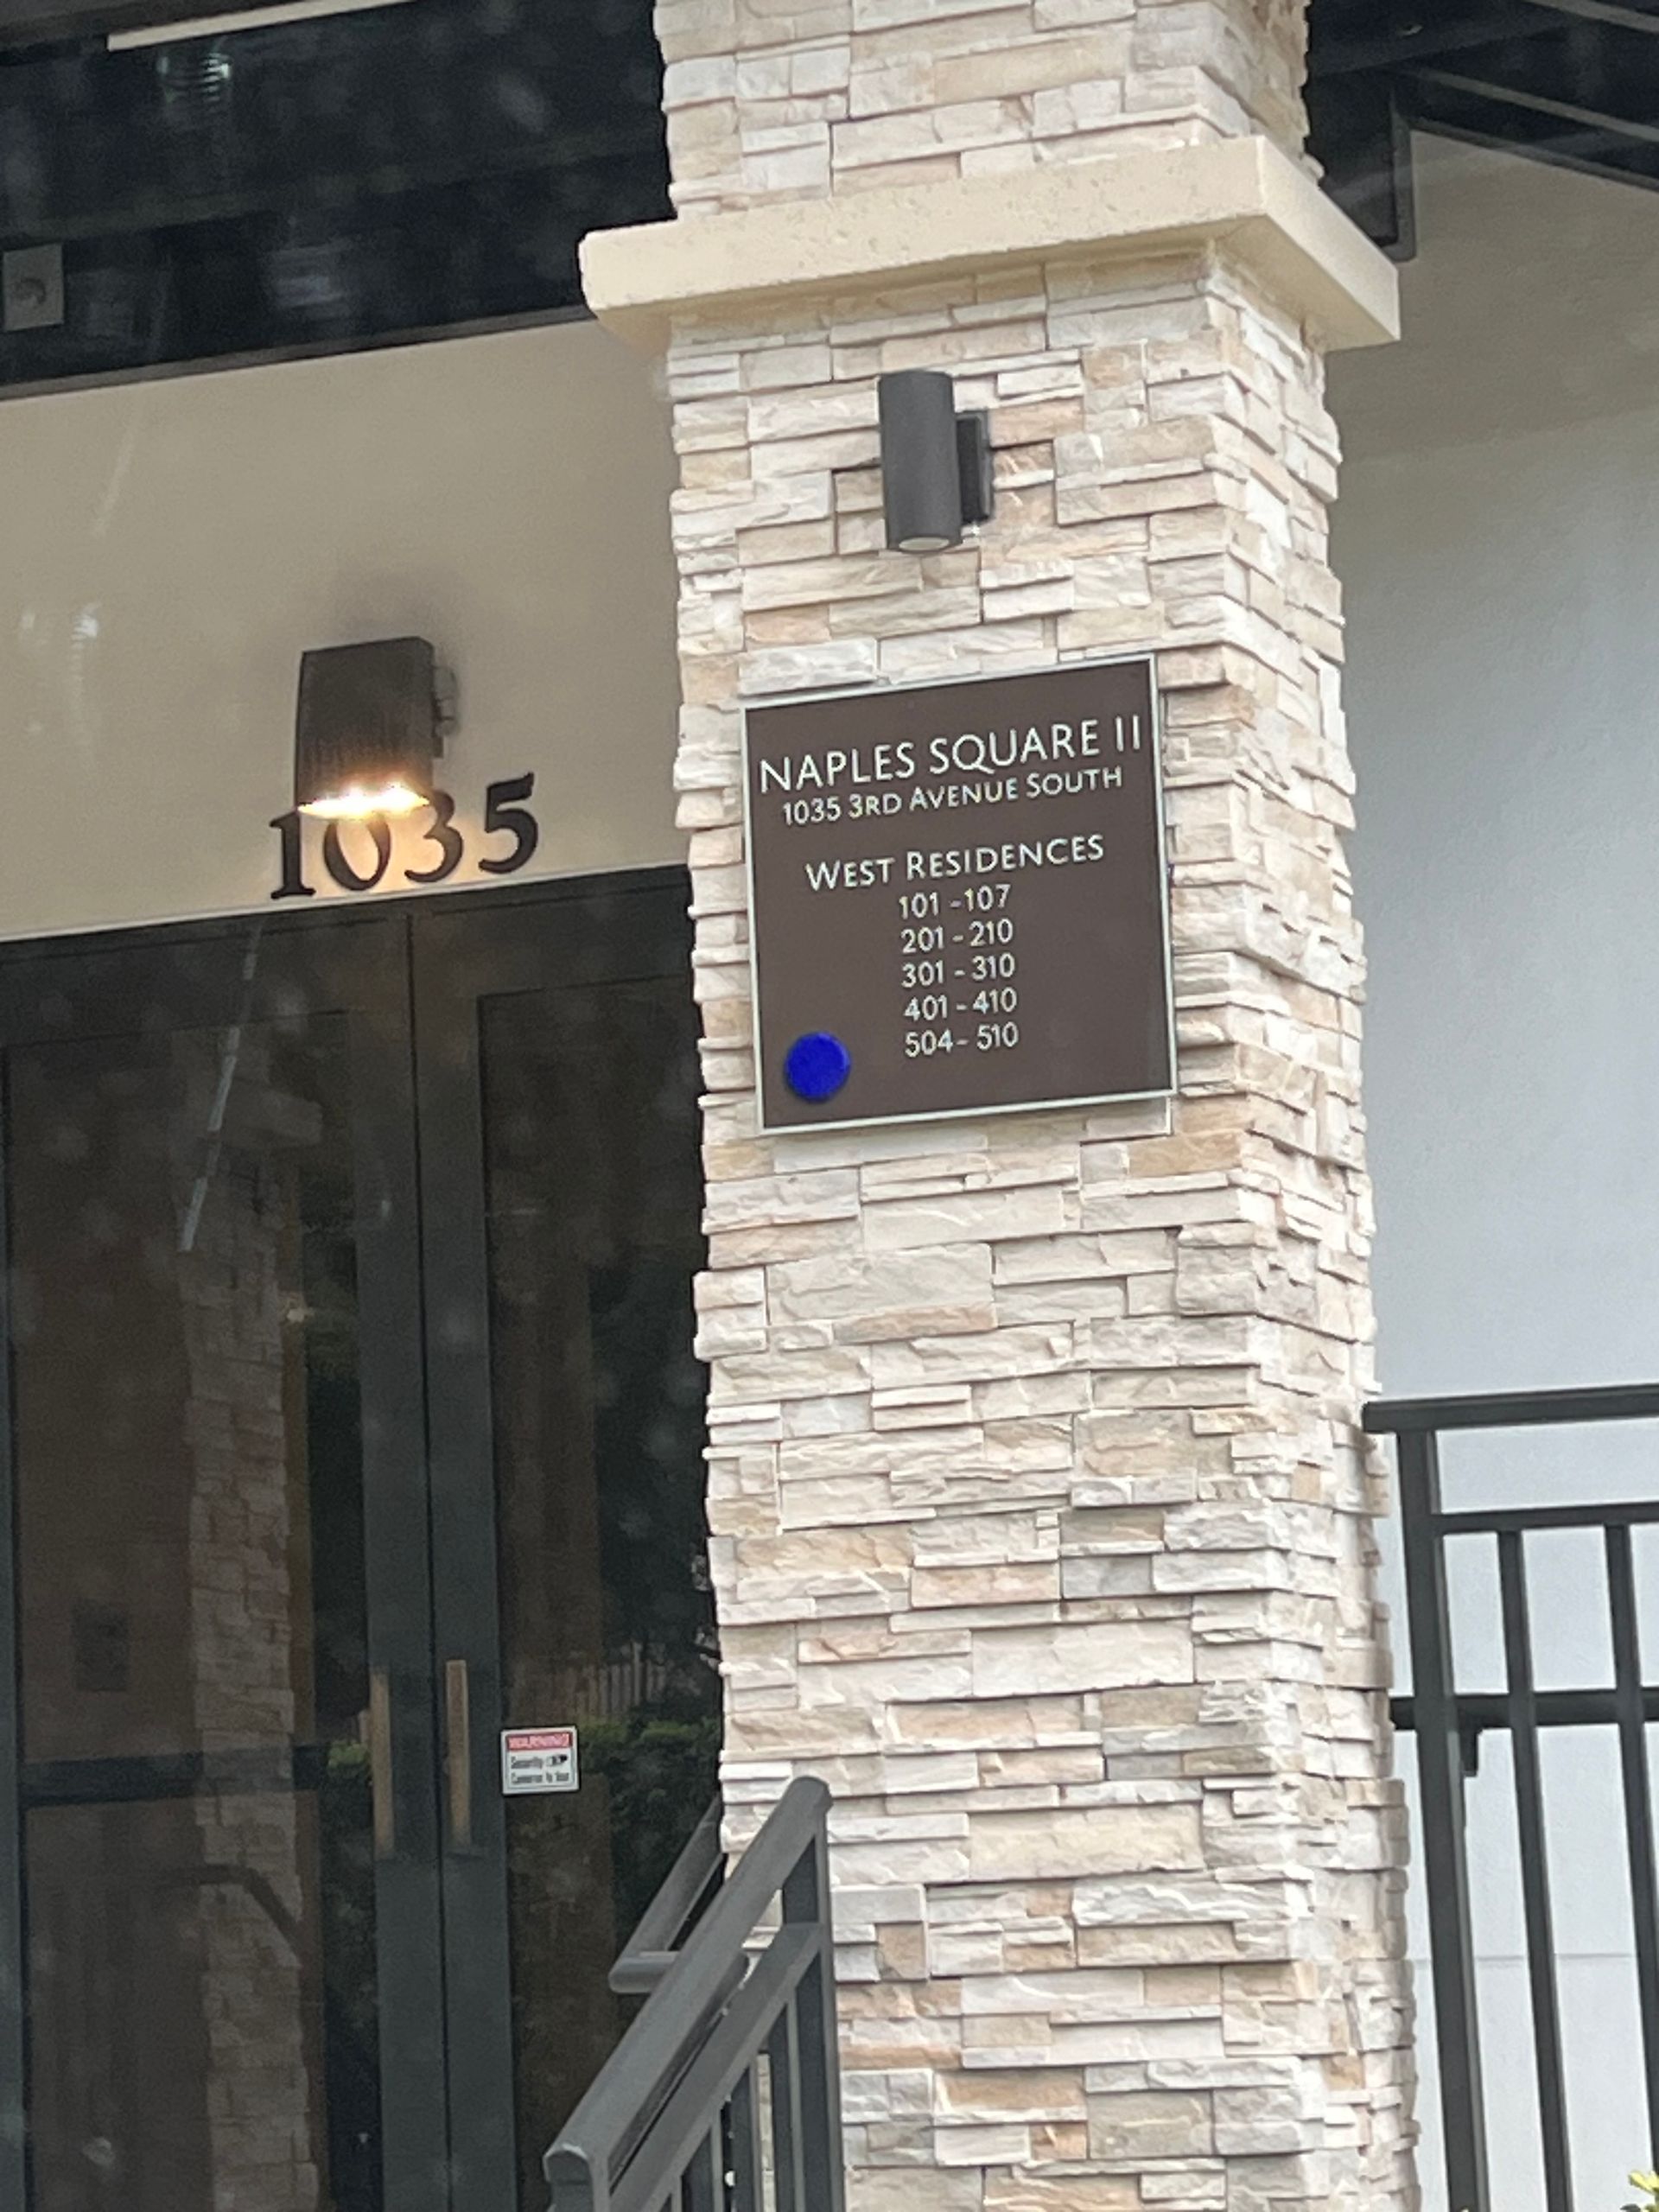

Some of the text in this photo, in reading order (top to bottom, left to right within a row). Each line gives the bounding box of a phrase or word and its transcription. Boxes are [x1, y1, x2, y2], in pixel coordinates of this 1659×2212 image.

[760, 715, 1141, 793] NAPLES SQUARE II
[783, 766, 1122, 825] 1035 3RD AVENUE SOUTH
[269, 772, 538, 899] 1035
[804, 834, 1104, 892] WEST RESIDENCES
[899, 892, 938, 919] 101
[963, 883, 1011, 912] 107
[900, 925, 944, 954] 201
[969, 918, 1014, 947] 210
[901, 960, 944, 988] 301
[971, 952, 1015, 981] 310
[904, 995, 947, 1021] 401
[972, 987, 1017, 1014] 410
[905, 1028, 953, 1058] 504
[976, 1021, 1019, 1050] 510
